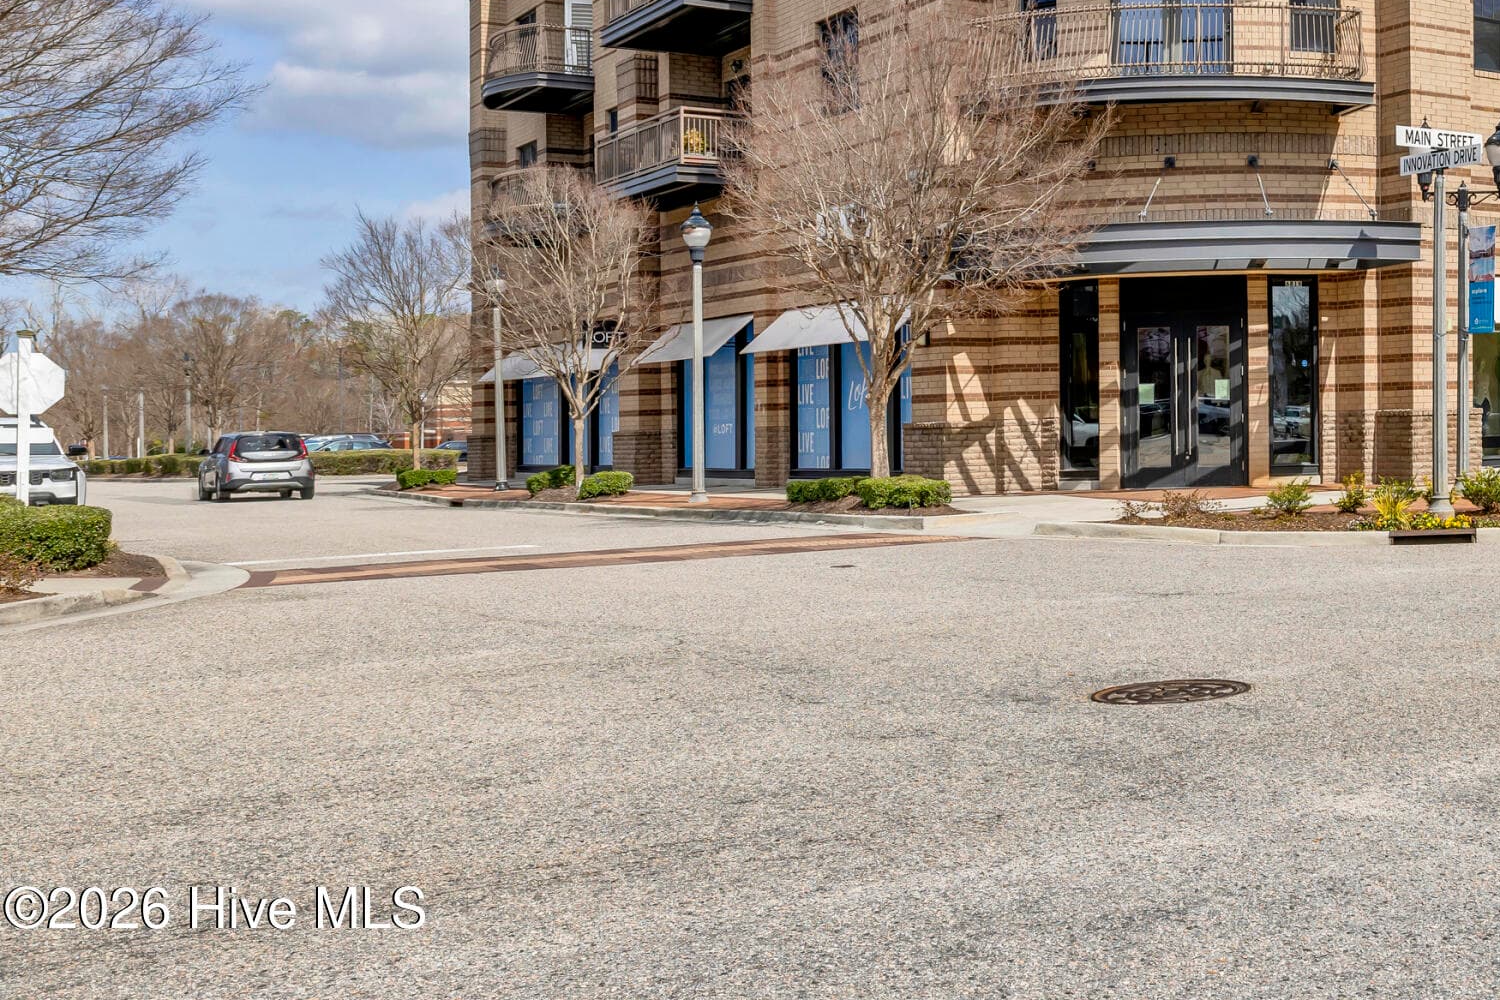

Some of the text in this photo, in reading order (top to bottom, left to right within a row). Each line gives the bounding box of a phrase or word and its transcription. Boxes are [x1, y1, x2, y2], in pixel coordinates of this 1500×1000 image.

[1405, 129, 1475, 148] MAIN STREET
[1403, 147, 1477, 173] INNOVATION DRIVE
[585, 331, 625, 344] LOFT
[816, 359, 829, 380] LOF
[816, 408, 829, 429] LOF
